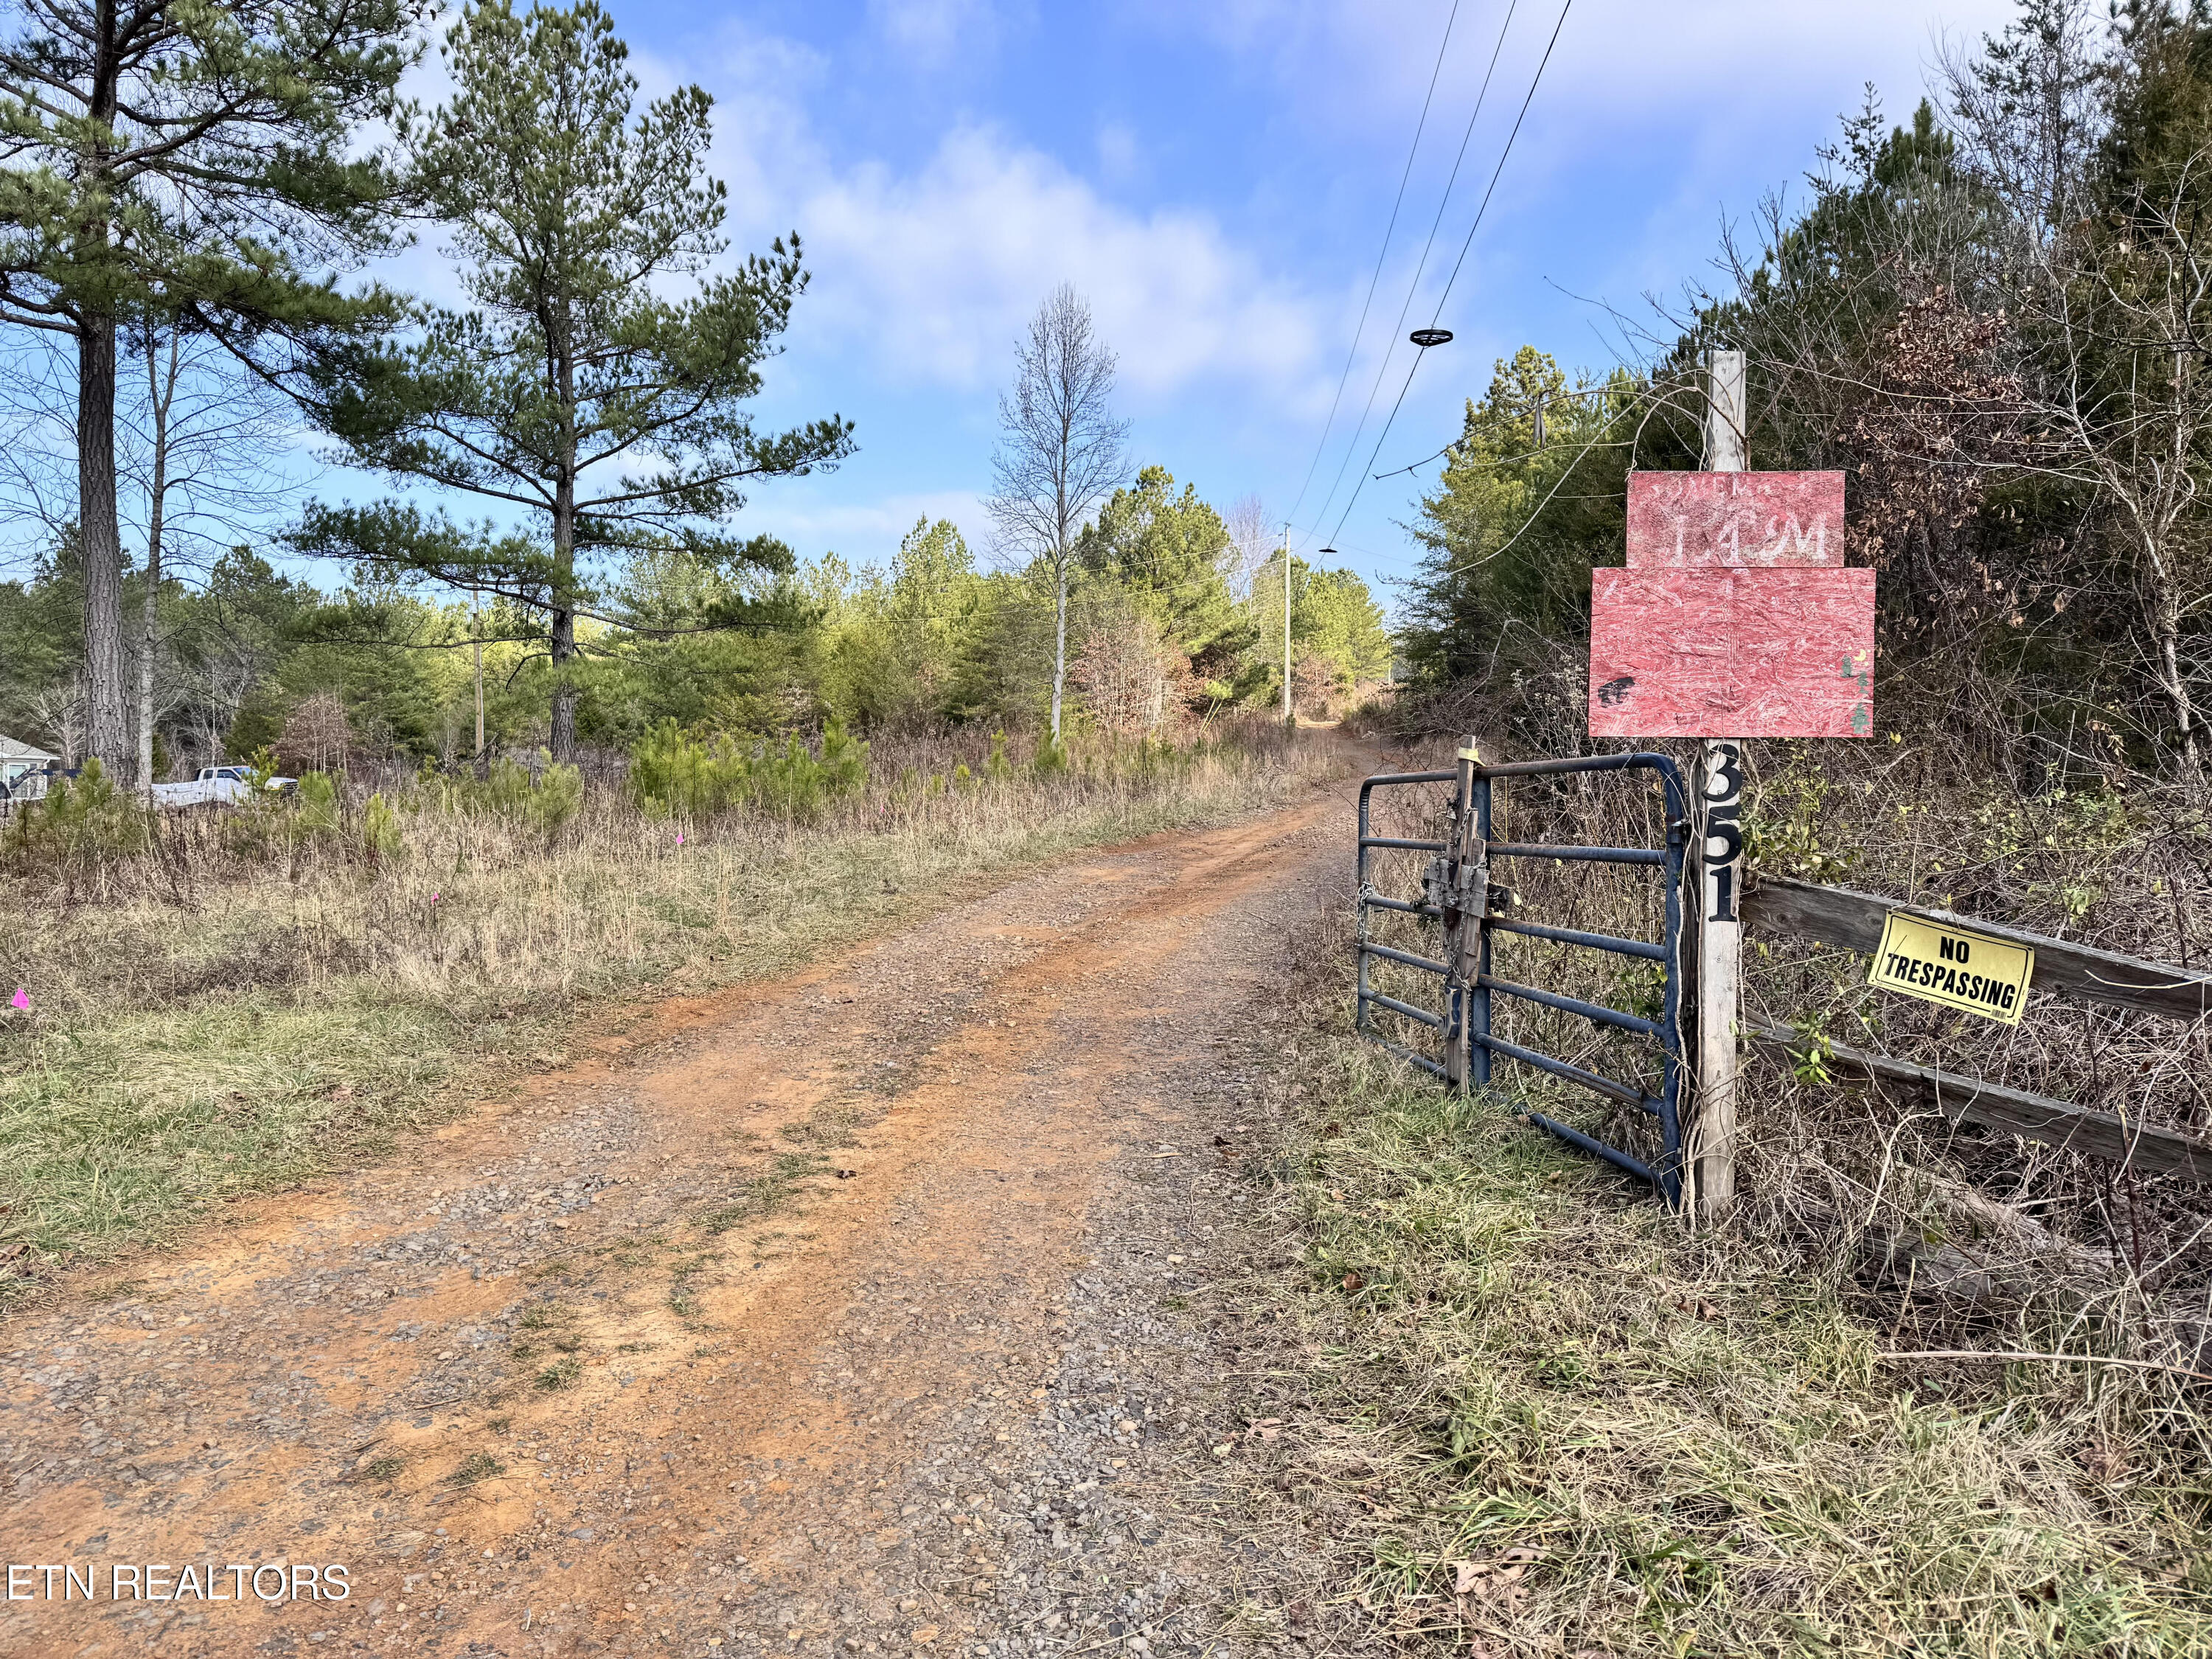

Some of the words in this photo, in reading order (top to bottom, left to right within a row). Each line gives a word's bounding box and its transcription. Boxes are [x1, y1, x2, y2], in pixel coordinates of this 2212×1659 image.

[1702, 744, 1743, 922] 351
[1940, 936, 1970, 964] NO
[1885, 953, 2016, 1009] TRESPASSING
